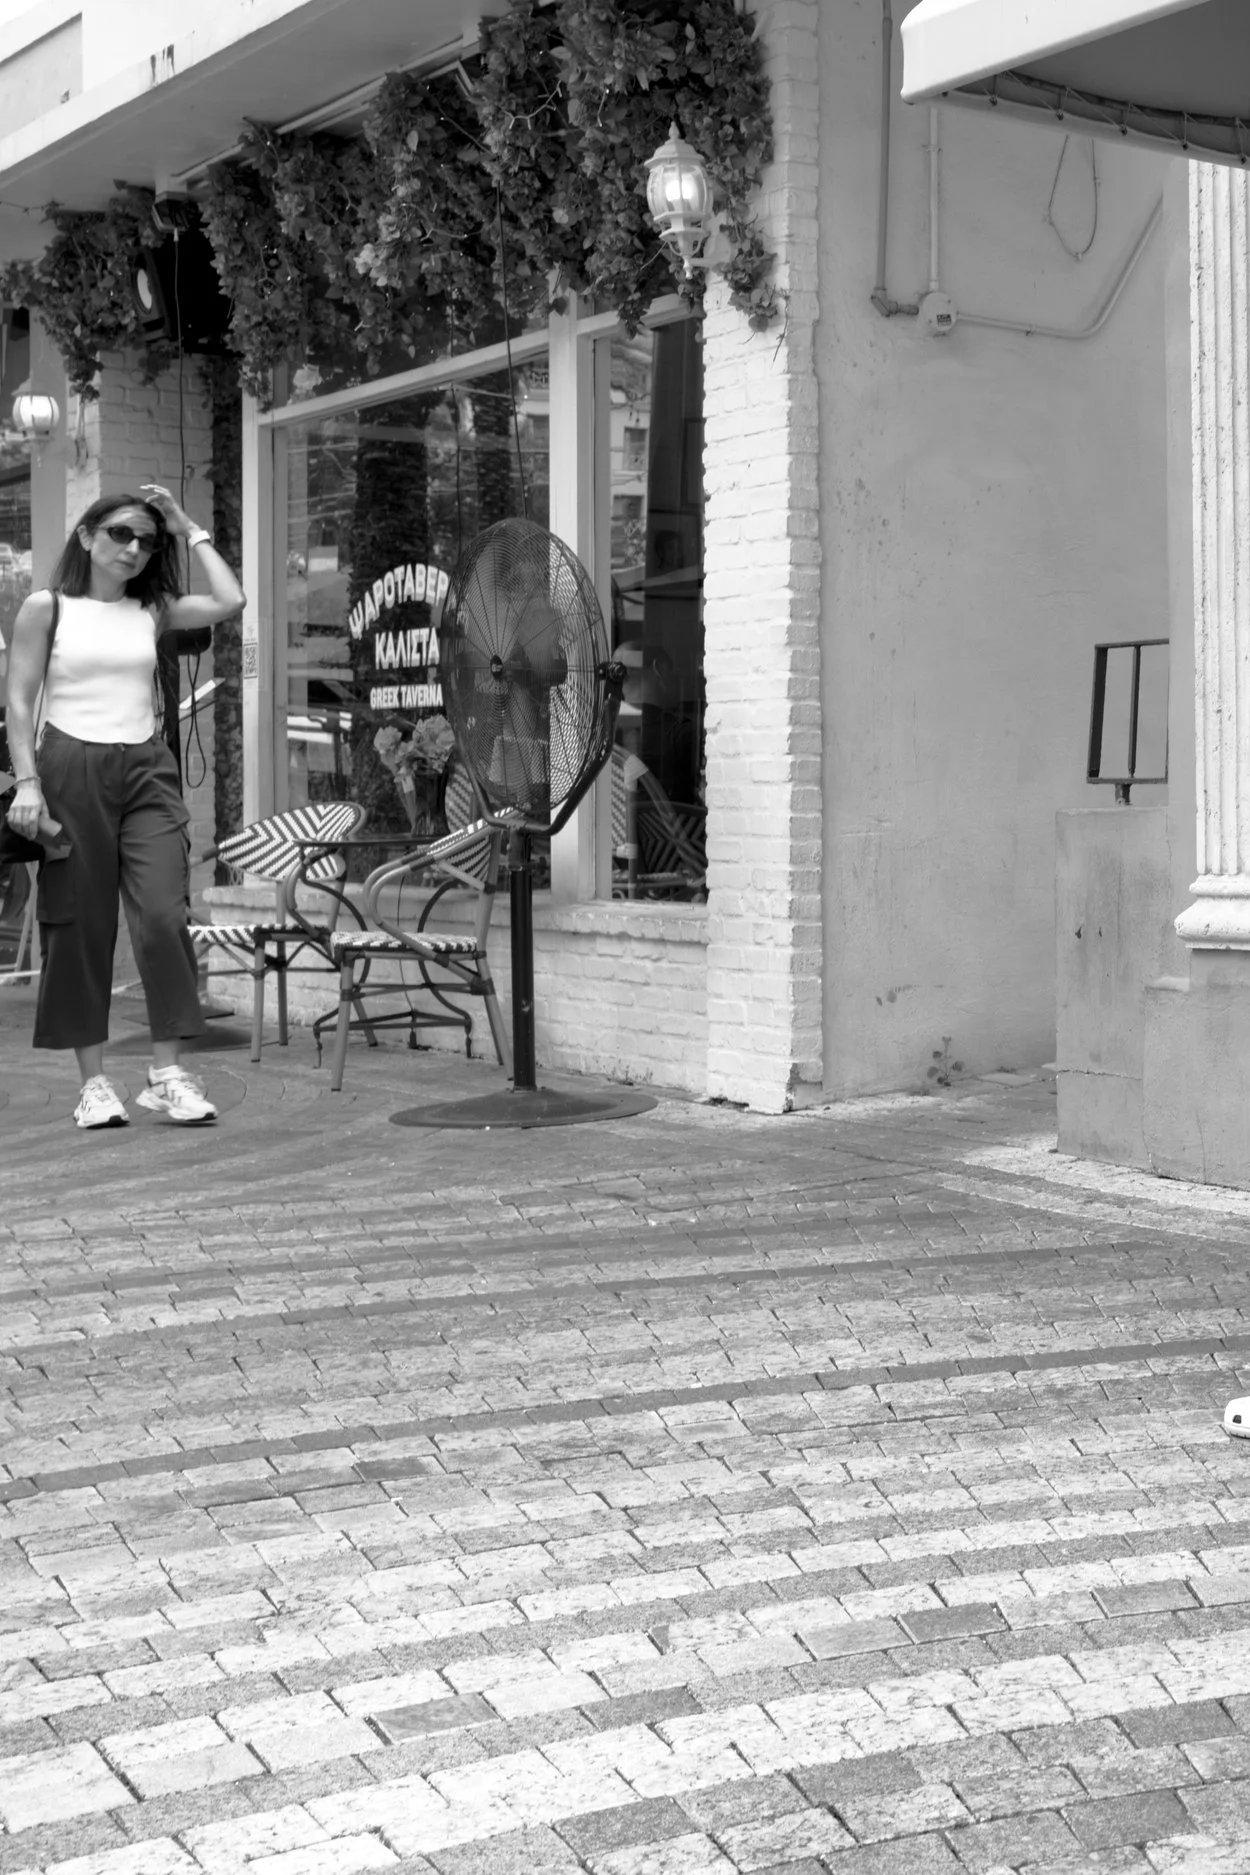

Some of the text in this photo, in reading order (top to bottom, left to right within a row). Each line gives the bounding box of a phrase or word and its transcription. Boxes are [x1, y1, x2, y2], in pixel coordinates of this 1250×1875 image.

[375, 627, 440, 670] ΚΑΛΙΣΤΑ
[370, 683, 443, 710] GREEK TAVERNA
